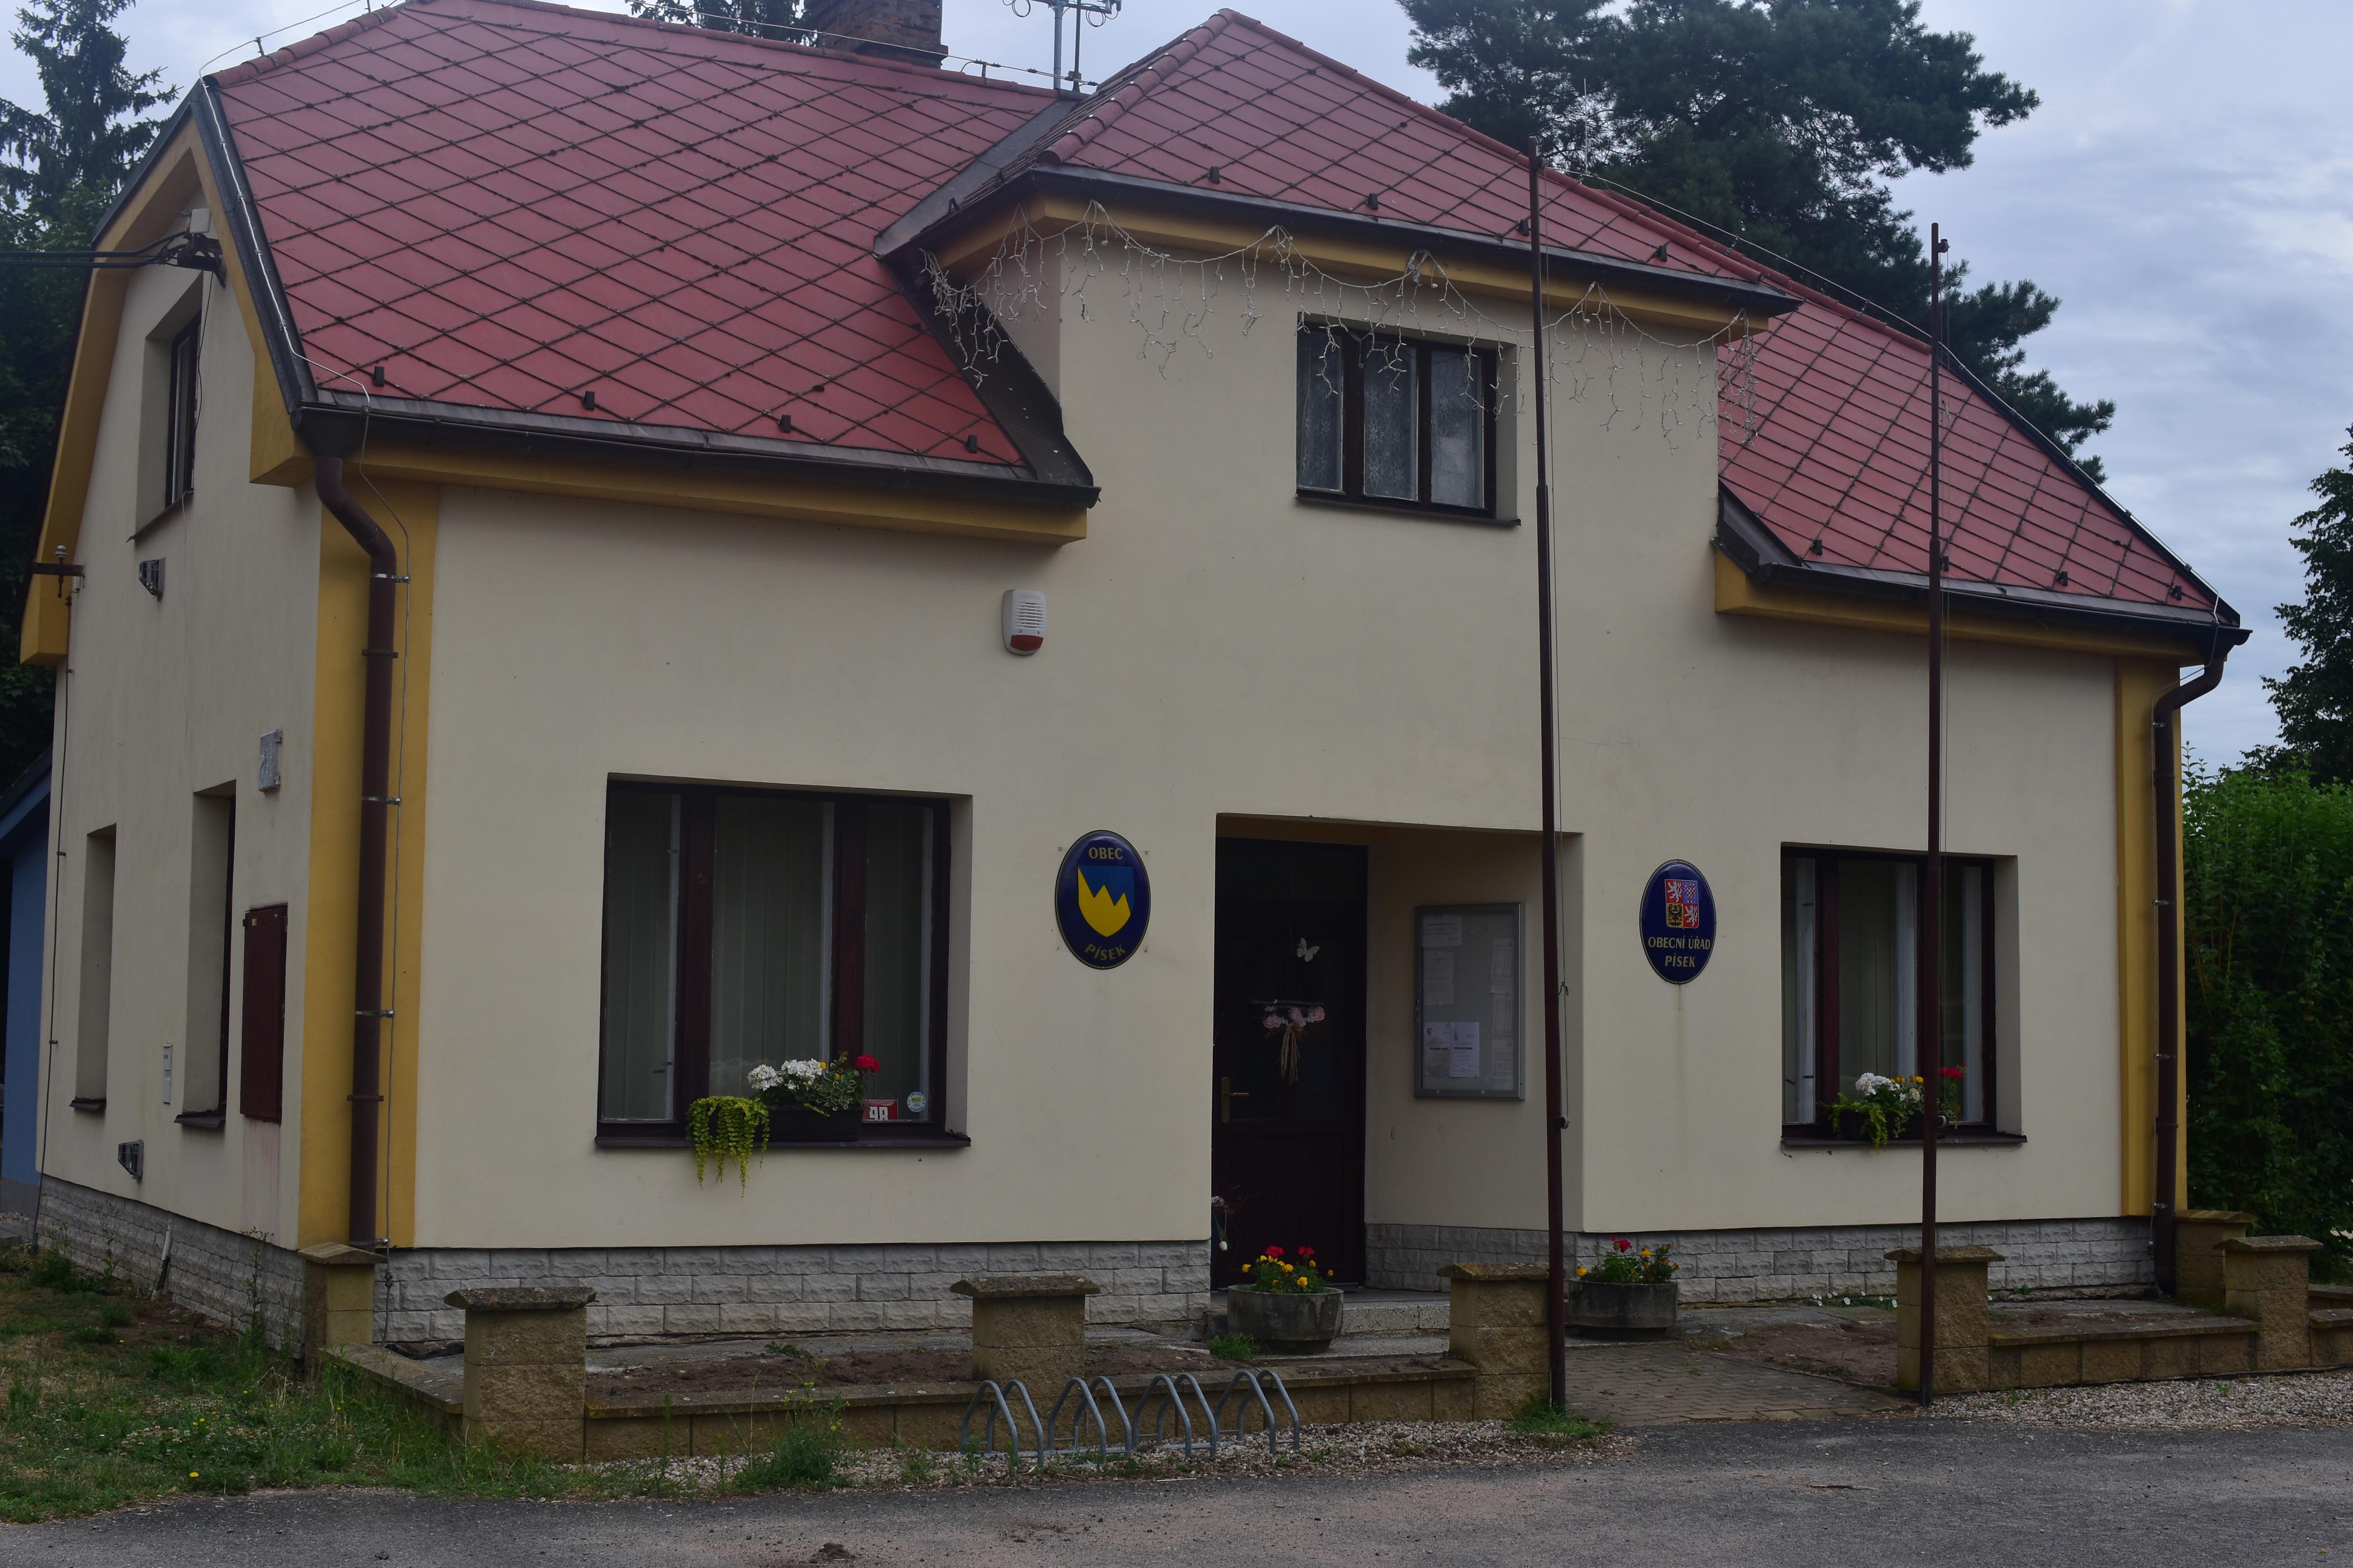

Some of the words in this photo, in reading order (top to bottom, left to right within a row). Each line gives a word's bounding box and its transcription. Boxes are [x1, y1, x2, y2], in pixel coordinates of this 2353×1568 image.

[1089, 848, 1123, 859] OBEC
[1648, 935, 1685, 949] OBECNÍ
[1688, 936, 1711, 950] ÚŘAD
[1084, 943, 1126, 960] PÍSEK
[1665, 953, 1695, 968] PÍSEK
[869, 1106, 888, 1120] 98
